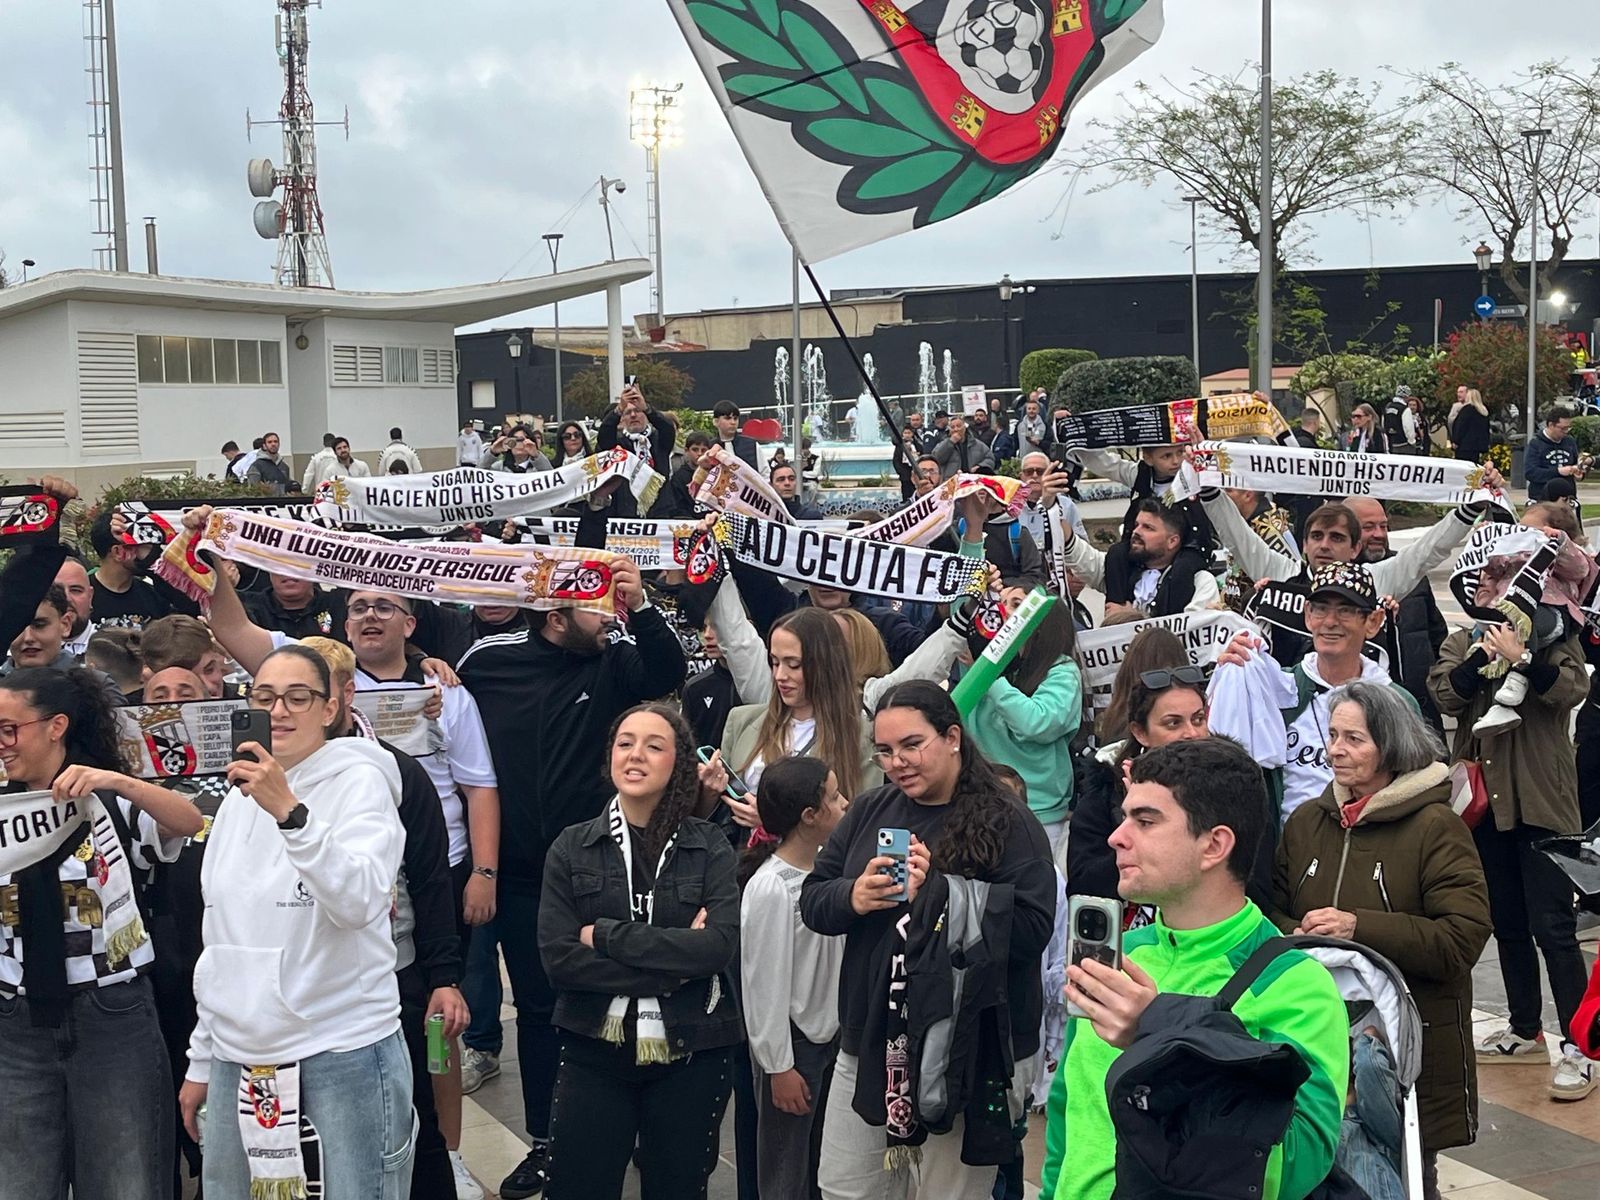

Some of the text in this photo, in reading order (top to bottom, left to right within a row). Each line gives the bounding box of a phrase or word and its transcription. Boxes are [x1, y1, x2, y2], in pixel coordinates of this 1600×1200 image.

[432, 470, 494, 488] SIGAMOS
[1250, 454, 1445, 484] HACIENDO HISTORIA
[366, 472, 565, 507] HACIENDO HISTORIA
[740, 485, 772, 516] UNA
[1319, 479, 1371, 495] JUNTOS
[440, 504, 494, 523] JUNTOS
[240, 521, 284, 548] UNA
[369, 551, 416, 573] NOS
[416, 557, 522, 583] PERSIGUE
[738, 517, 963, 598] AD CEUTA FC
[315, 562, 435, 593] #SIEMPREADCEUTAFC
